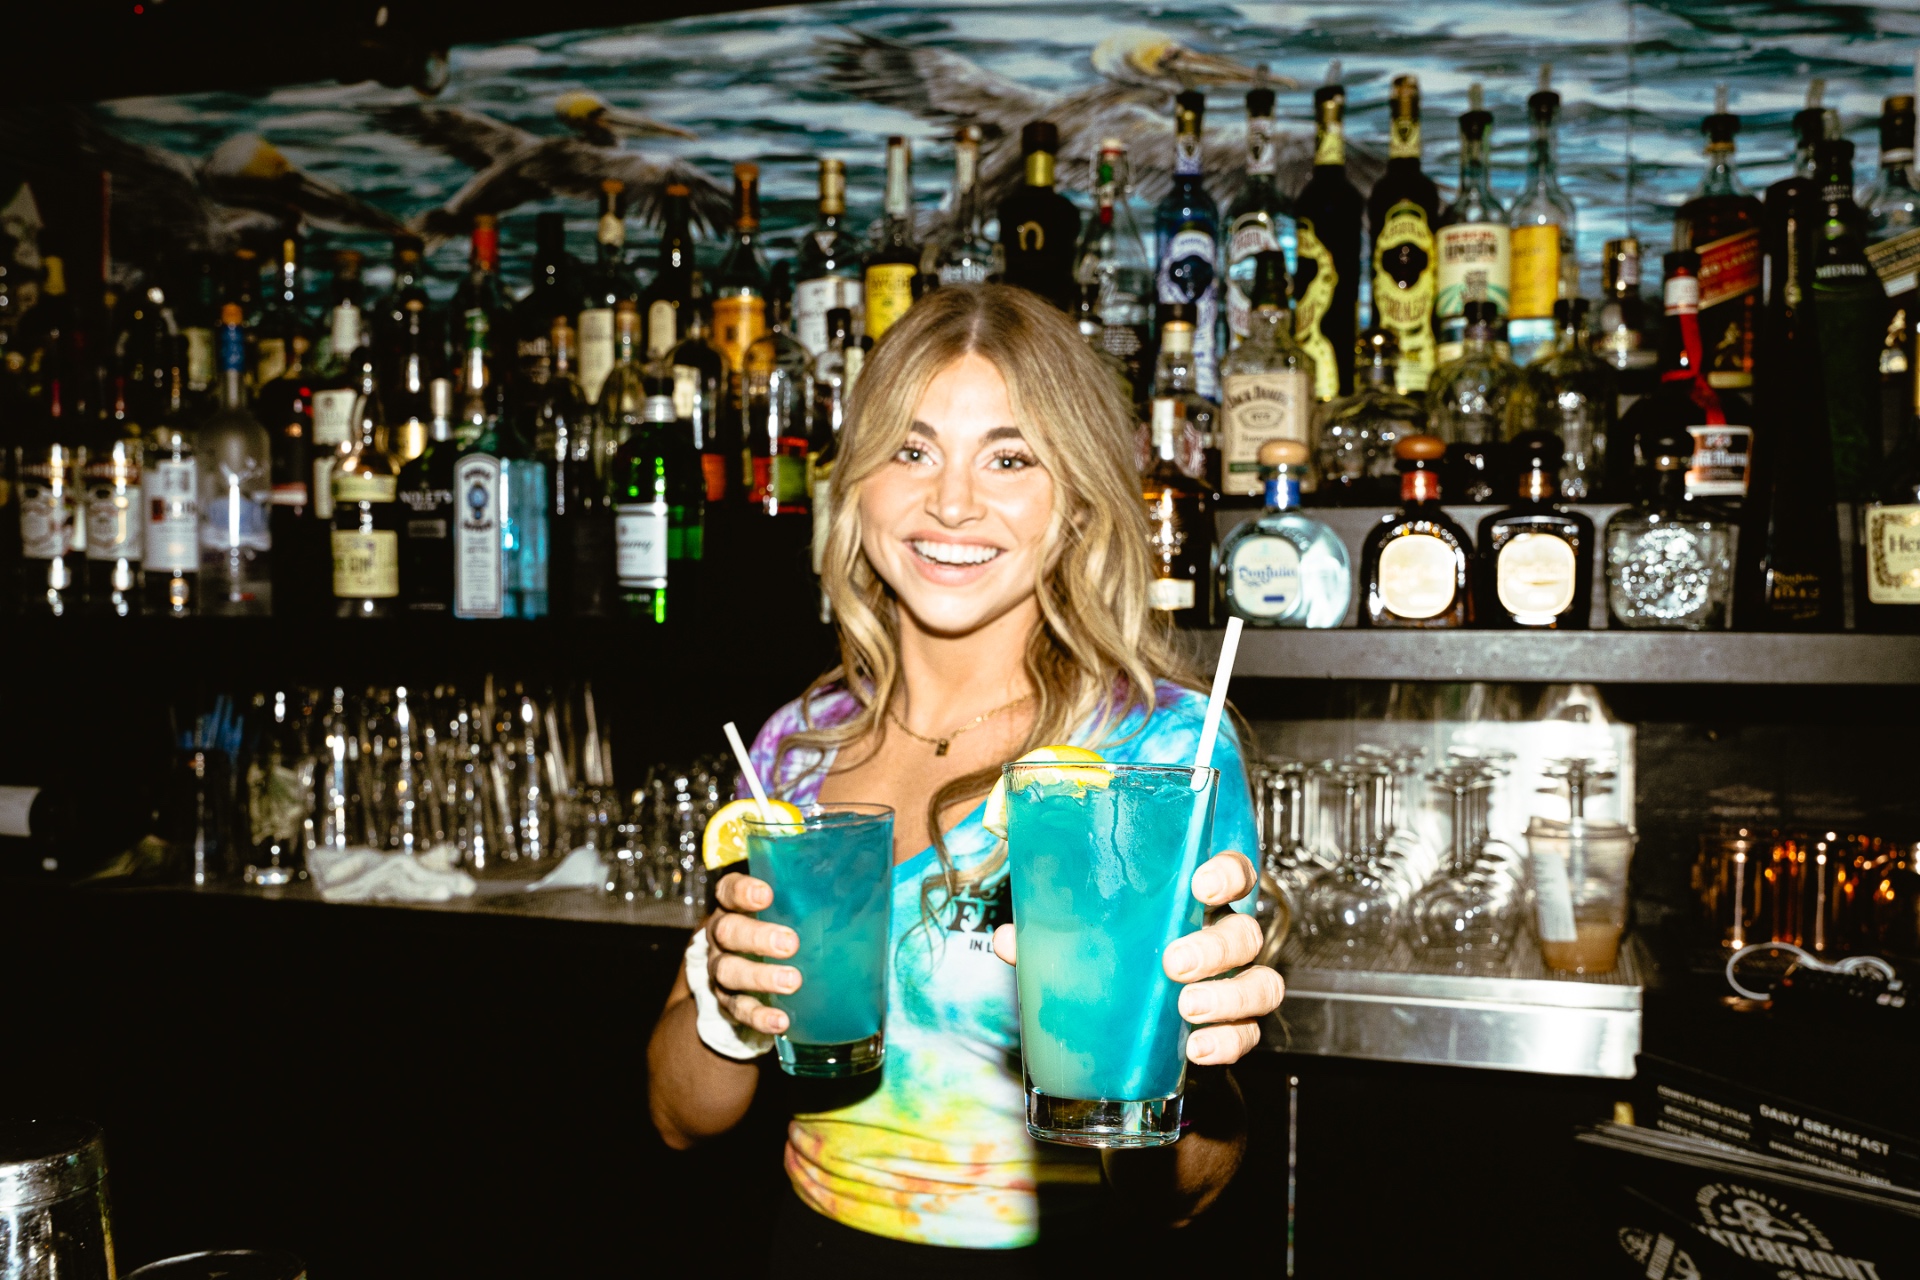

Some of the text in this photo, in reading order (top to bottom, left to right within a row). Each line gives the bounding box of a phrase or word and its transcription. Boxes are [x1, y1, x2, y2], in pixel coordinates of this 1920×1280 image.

[969, 939, 983, 951] IN
[1759, 1104, 1801, 1127] DAILY
[1802, 1117, 1890, 1157] BREAKFAST
